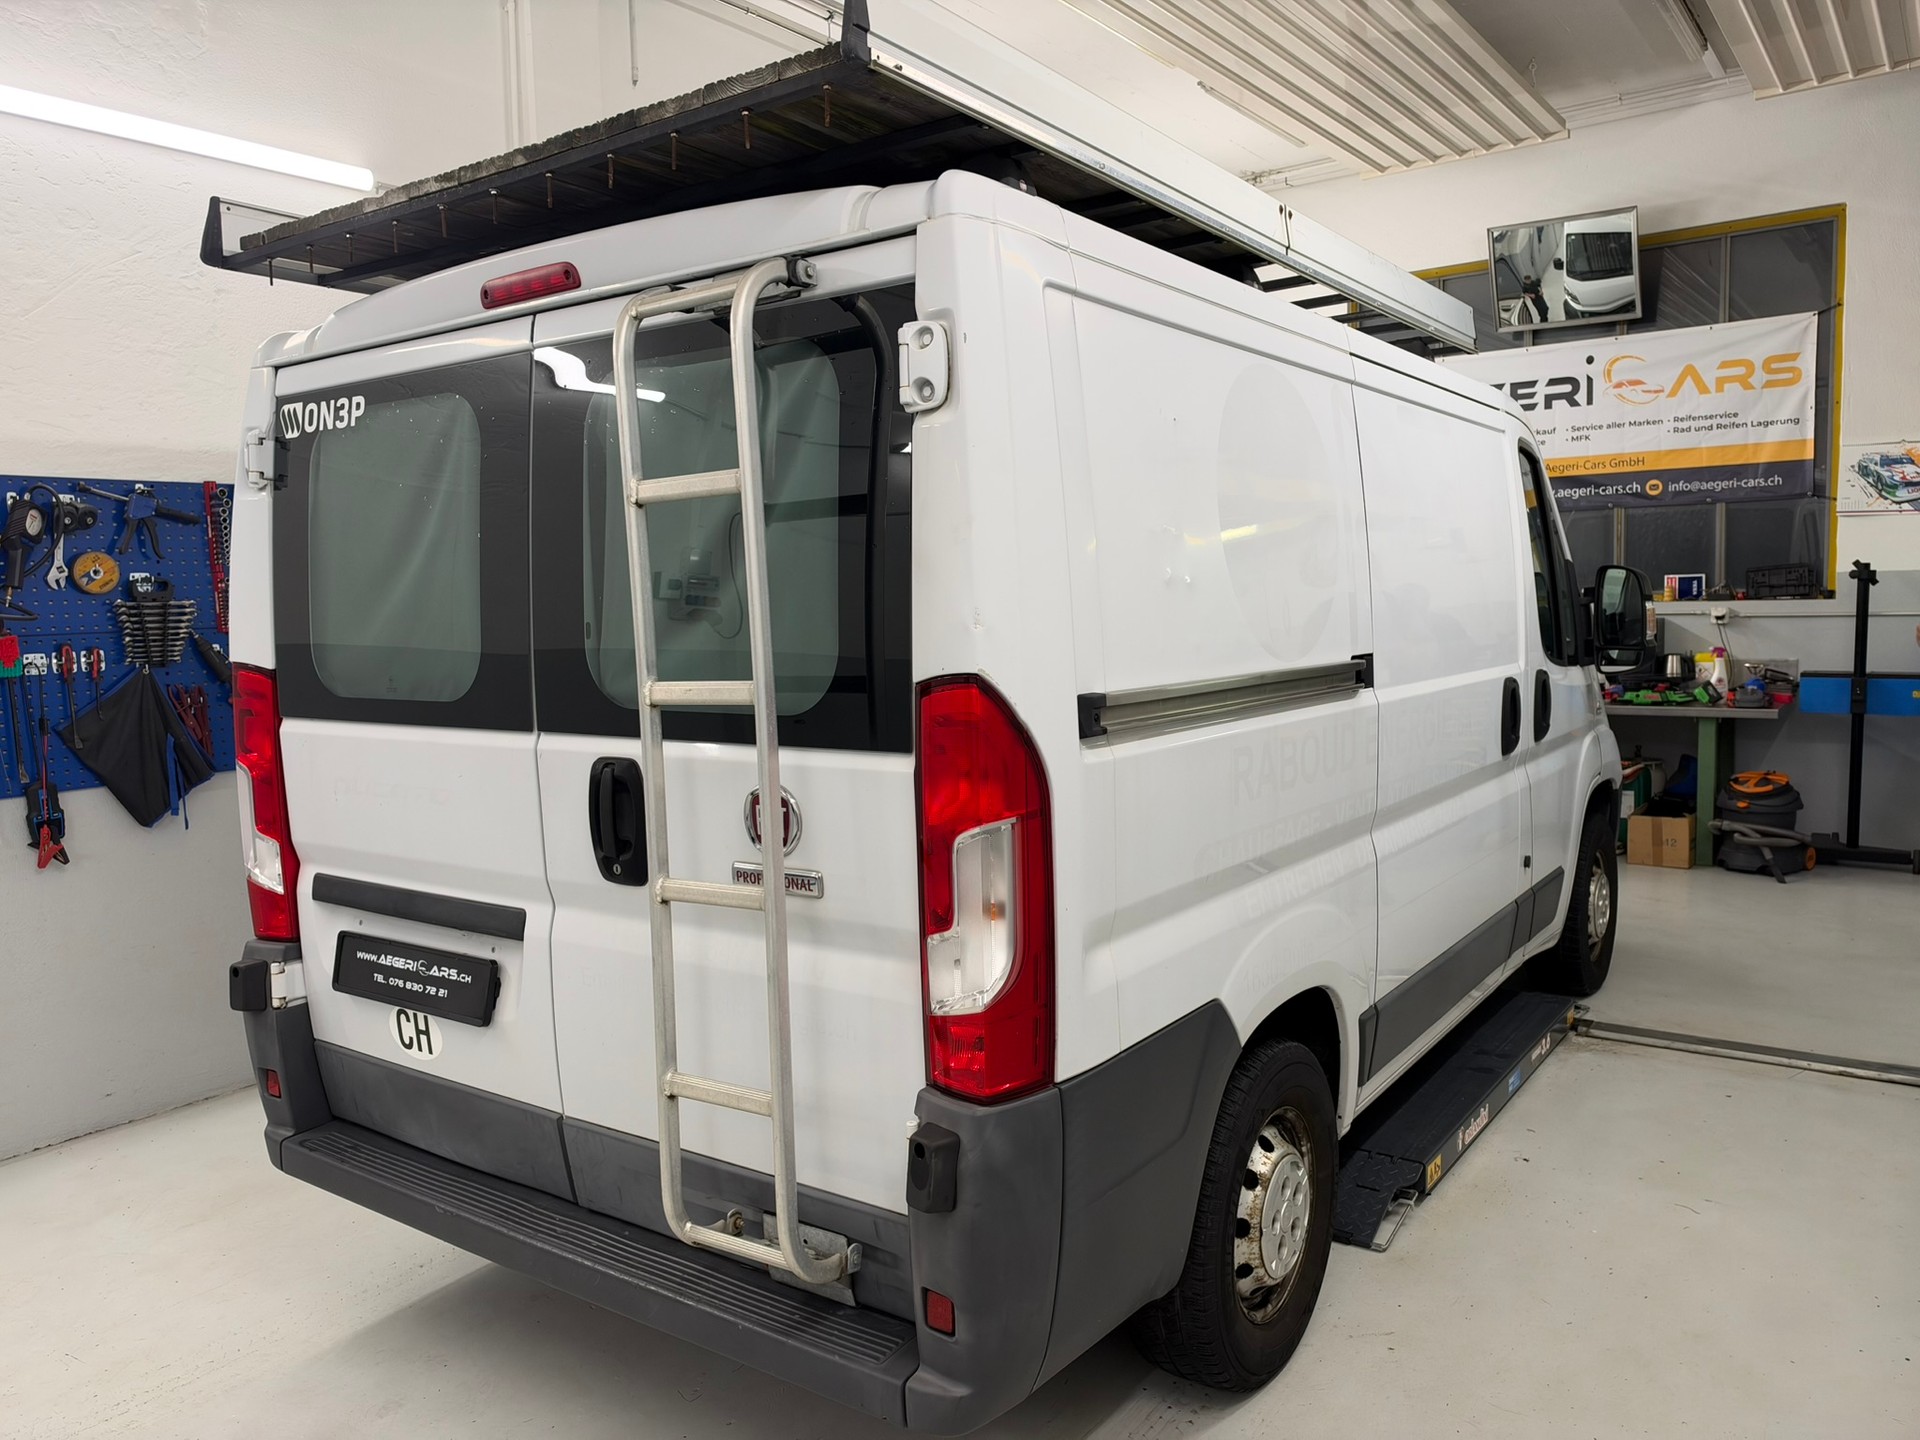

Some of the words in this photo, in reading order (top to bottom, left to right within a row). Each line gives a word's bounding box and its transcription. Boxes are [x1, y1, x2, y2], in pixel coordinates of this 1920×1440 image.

[304, 395, 365, 433] ON3P
[1673, 411, 1739, 423] Reifenservice
[1534, 427, 1557, 436] kauf
[1571, 422, 1604, 433] Service
[1606, 421, 1626, 430] aller
[1628, 418, 1664, 428] Marken
[1673, 425, 1692, 434] Rad
[1694, 424, 1713, 433] und
[1716, 421, 1748, 430] Reifen
[1751, 417, 1800, 428] Lagerung
[1571, 434, 1591, 443] MFK
[1546, 459, 1607, 474] Aegeri-Cars
[1609, 456, 1645, 468] GmbH
[1668, 474, 1782, 492] info@aegeri-cars.ch
[736, 870, 814, 892] PROFONAL
[373, 973, 387, 984] TEL.
[388, 977, 404, 988] 076
[405, 981, 424, 993] 830
[425, 984, 436, 995] 72
[438, 987, 448, 998] 21
[395, 1008, 434, 1056] CH
